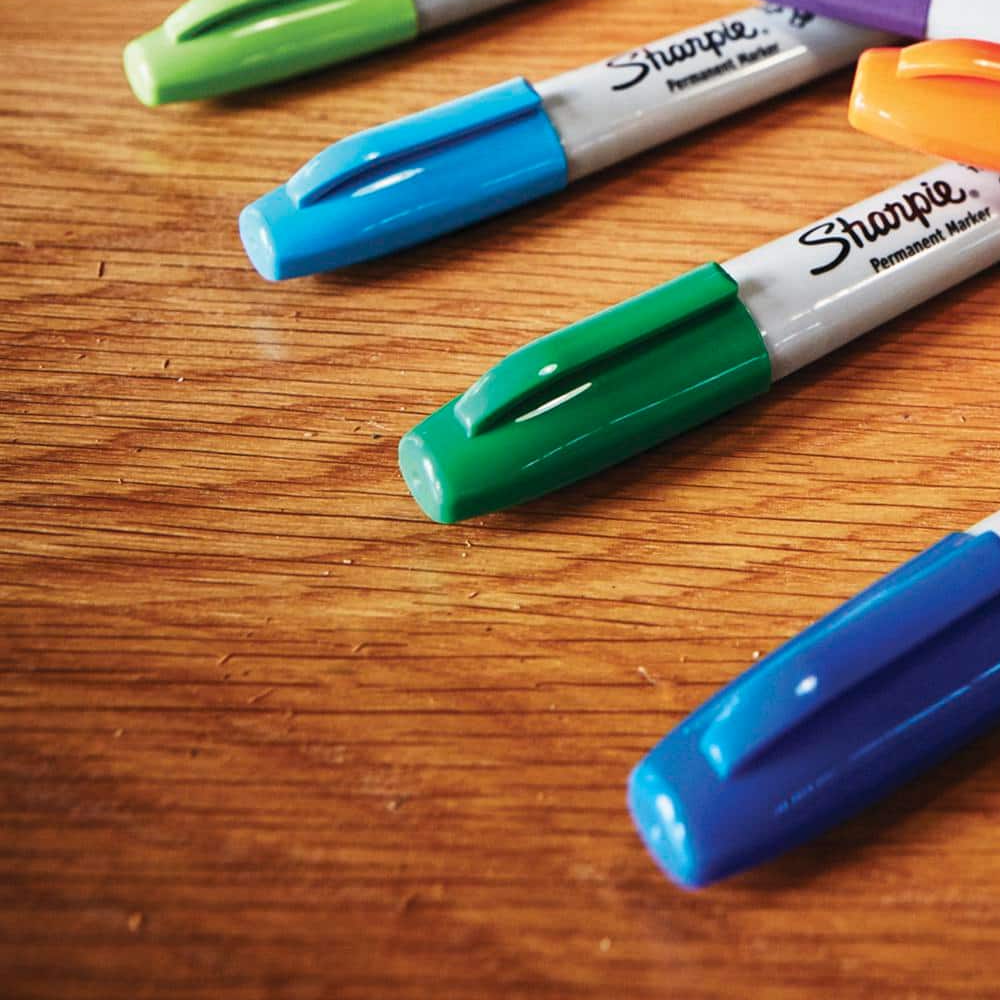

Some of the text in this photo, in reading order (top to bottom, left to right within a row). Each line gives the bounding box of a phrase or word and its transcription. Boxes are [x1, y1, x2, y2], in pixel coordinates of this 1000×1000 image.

[606, 20, 758, 92] Sharpie
[666, 42, 780, 92] Permanent Marker
[798, 180, 967, 276] Sharpie
[870, 206, 992, 273] Permanent Marker
